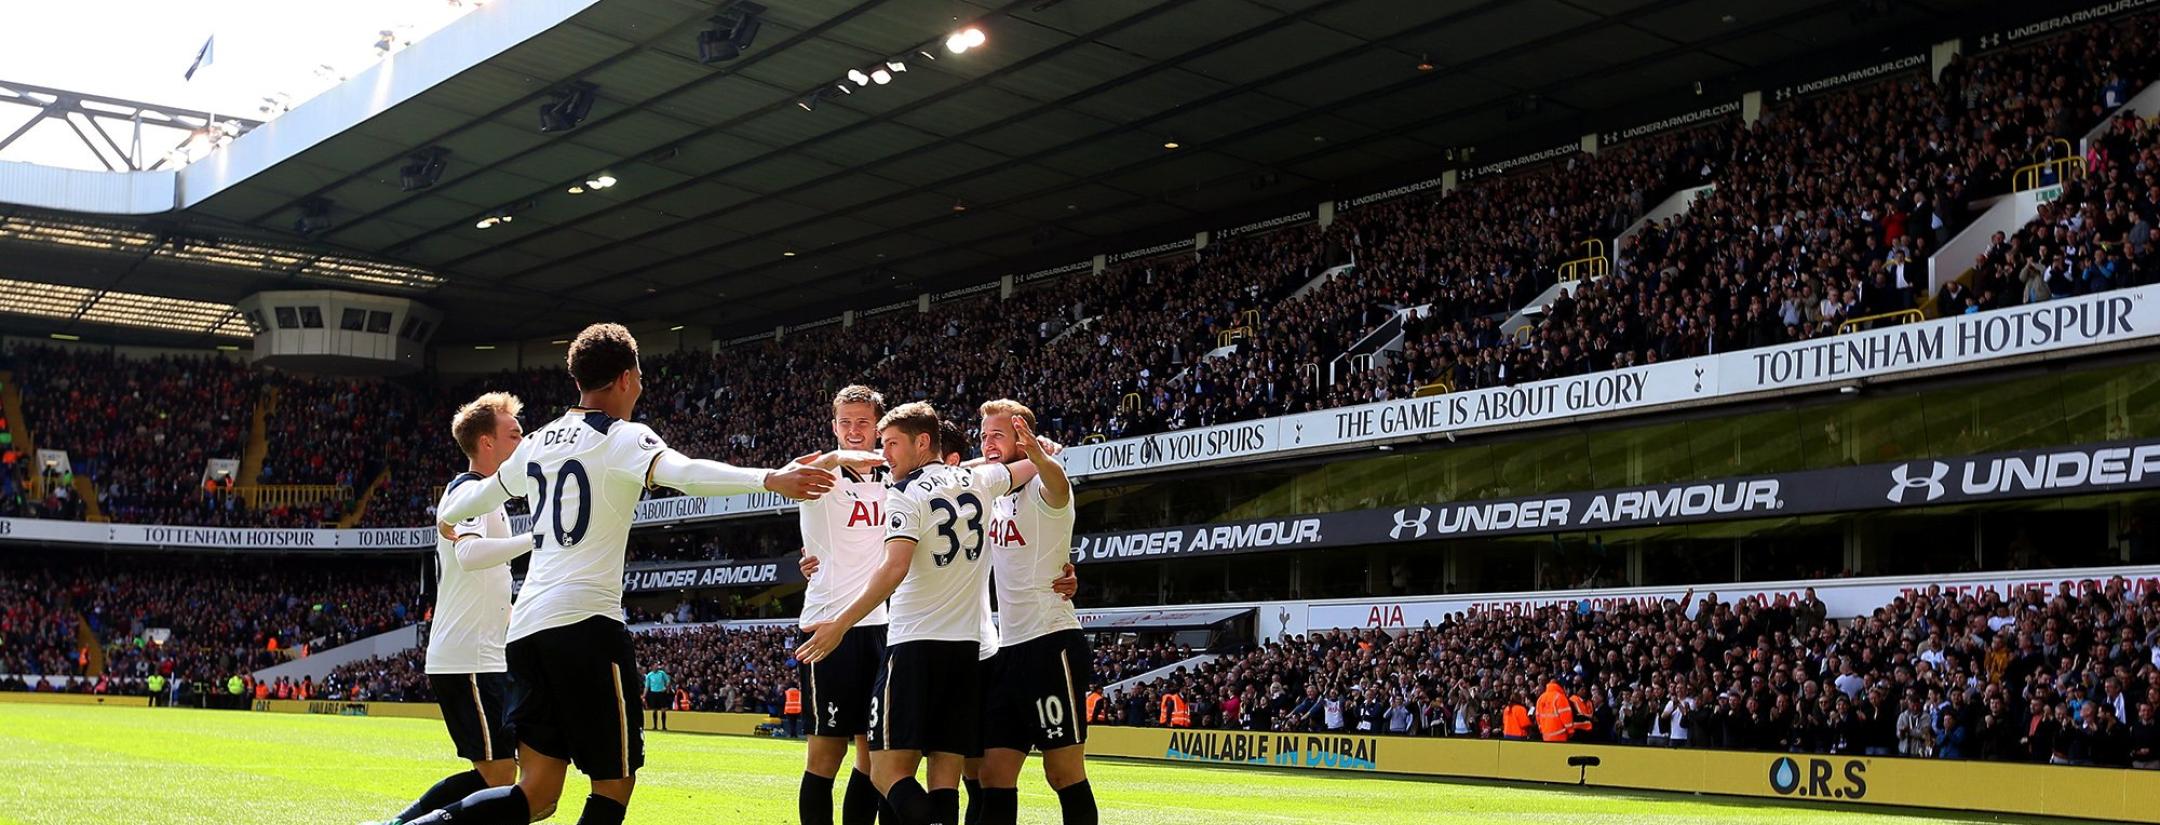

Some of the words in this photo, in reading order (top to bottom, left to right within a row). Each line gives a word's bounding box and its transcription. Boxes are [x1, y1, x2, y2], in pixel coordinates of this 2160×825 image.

[2007, 0, 2159, 41] UNDERARMOUR.C
[1797, 54, 1926, 94] UNDERARMOUR.COM
[1622, 101, 1740, 139] UNDERARMOUR.COM
[1753, 326, 1944, 386] TOTTENHAM
[1957, 296, 2134, 356] HOTSPUR
[1336, 410, 1375, 439] THE
[1380, 400, 1442, 433] GAME
[1448, 396, 1468, 425] IS
[1474, 384, 1560, 422] ABOUT
[1566, 371, 1649, 411] GLORY
[1093, 443, 1136, 470] COME
[1140, 437, 1164, 465] ON
[1169, 433, 1203, 460] YOU
[1206, 424, 1265, 456] SPURS
[918, 473, 970, 492] DAVS
[1962, 443, 2160, 495] UNDER
[641, 499, 675, 520] ABOUT
[676, 496, 709, 517] GLORY
[1437, 498, 1571, 534] UNDER
[1580, 479, 1780, 525] ARMOUR
[144, 527, 242, 545] TOTTENHAM
[246, 530, 314, 546] HOTSPUR
[358, 532, 372, 546] TO
[375, 531, 407, 546] DARE
[410, 531, 421, 545] IS
[929, 492, 985, 568] 33
[988, 518, 1026, 547] AIA
[1093, 530, 1183, 559] UNDER
[1187, 518, 1321, 552] ARMOUR
[641, 569, 698, 589] UNDER
[698, 564, 777, 586] ARMOUR
[1366, 605, 1405, 627] AIA
[1036, 695, 1064, 729] 10
[1165, 731, 1269, 763] AVAILABLE
[1275, 736, 1299, 767] IN
[1306, 736, 1377, 770] DUBAI
